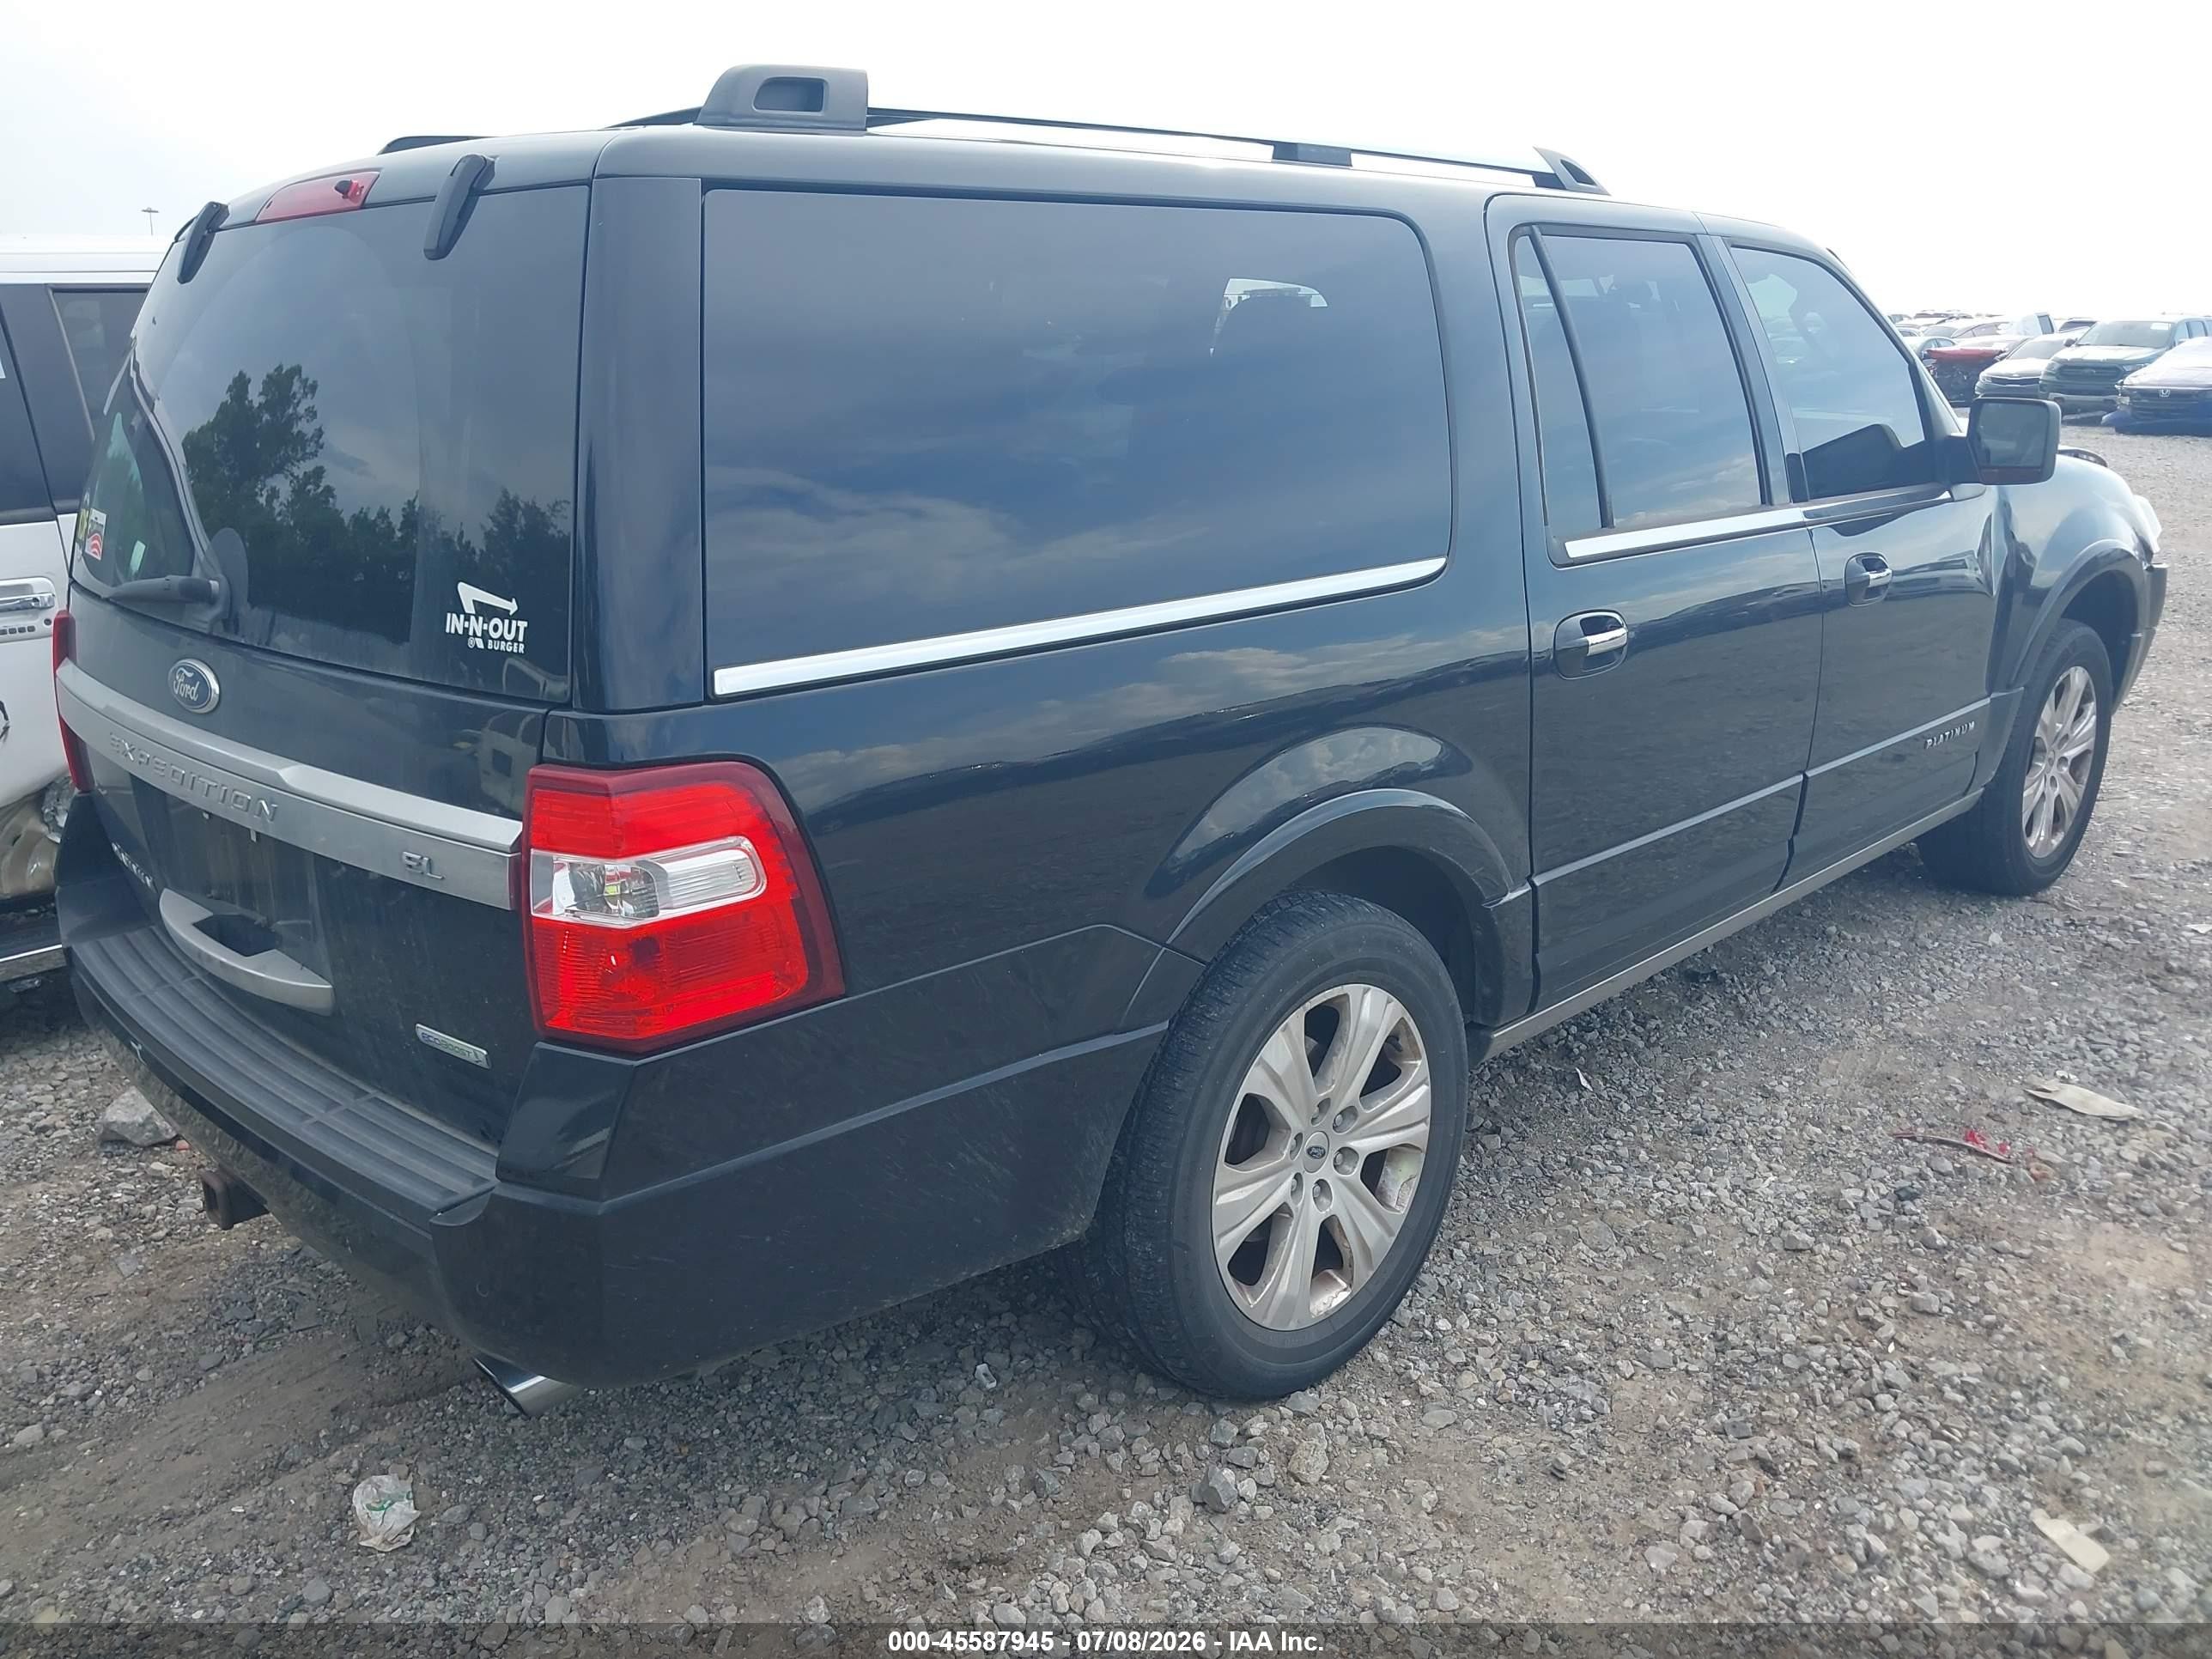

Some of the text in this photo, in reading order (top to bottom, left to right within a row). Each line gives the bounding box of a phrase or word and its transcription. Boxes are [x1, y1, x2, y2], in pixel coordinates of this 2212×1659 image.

[446, 612, 528, 642] IN-N-OUT
[487, 639, 526, 654] BURGER
[173, 666, 200, 702] Ford
[1925, 721, 1976, 750] PLATINUM
[109, 732, 279, 823] EXPEDITION
[402, 851, 447, 880] EL
